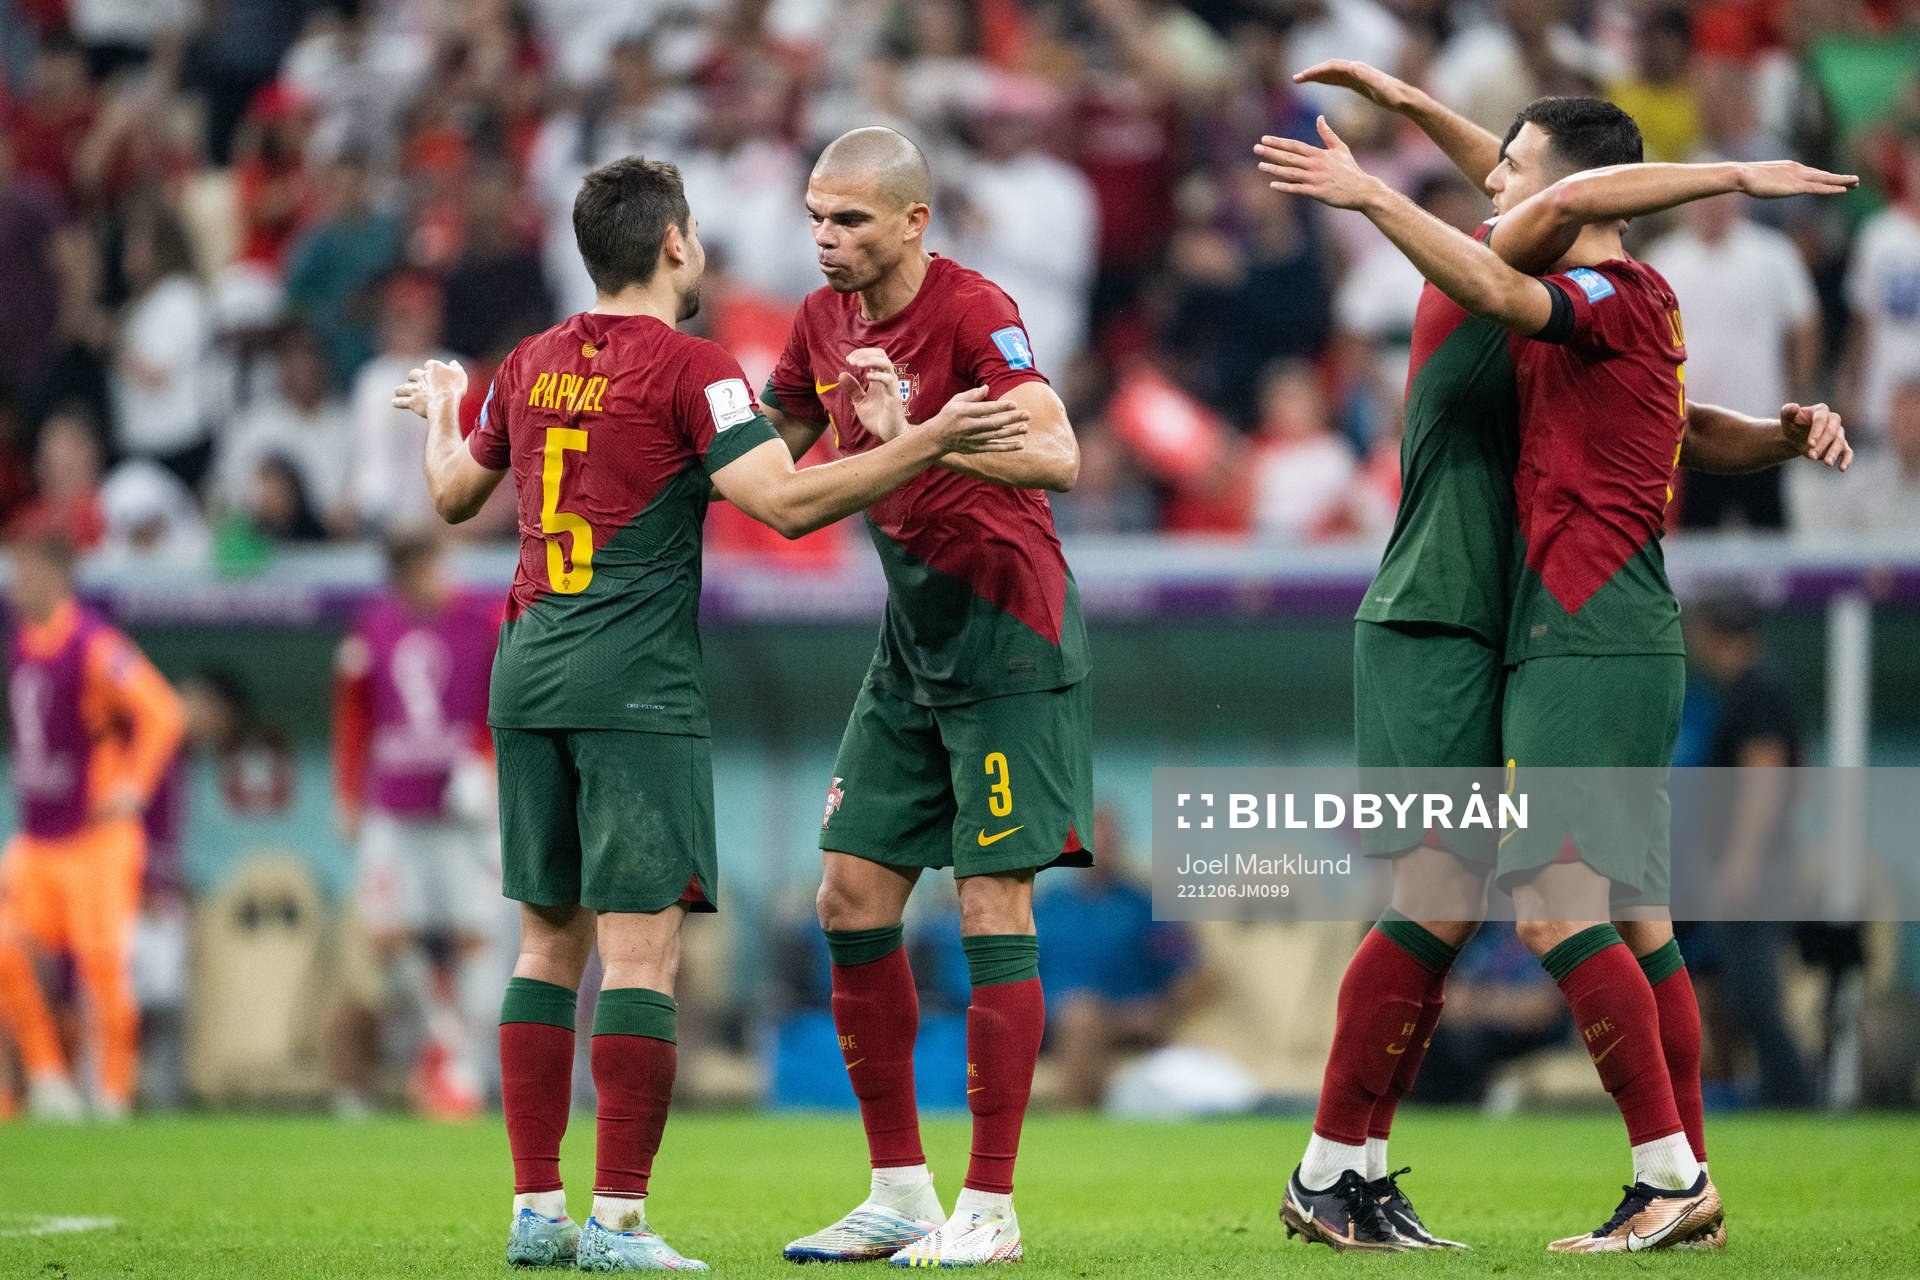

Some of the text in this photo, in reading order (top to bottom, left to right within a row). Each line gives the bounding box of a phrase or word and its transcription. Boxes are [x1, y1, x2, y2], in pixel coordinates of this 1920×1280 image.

[528, 372, 609, 412] RAPHAEL
[541, 427, 593, 594] 5
[984, 752, 1012, 817] 3
